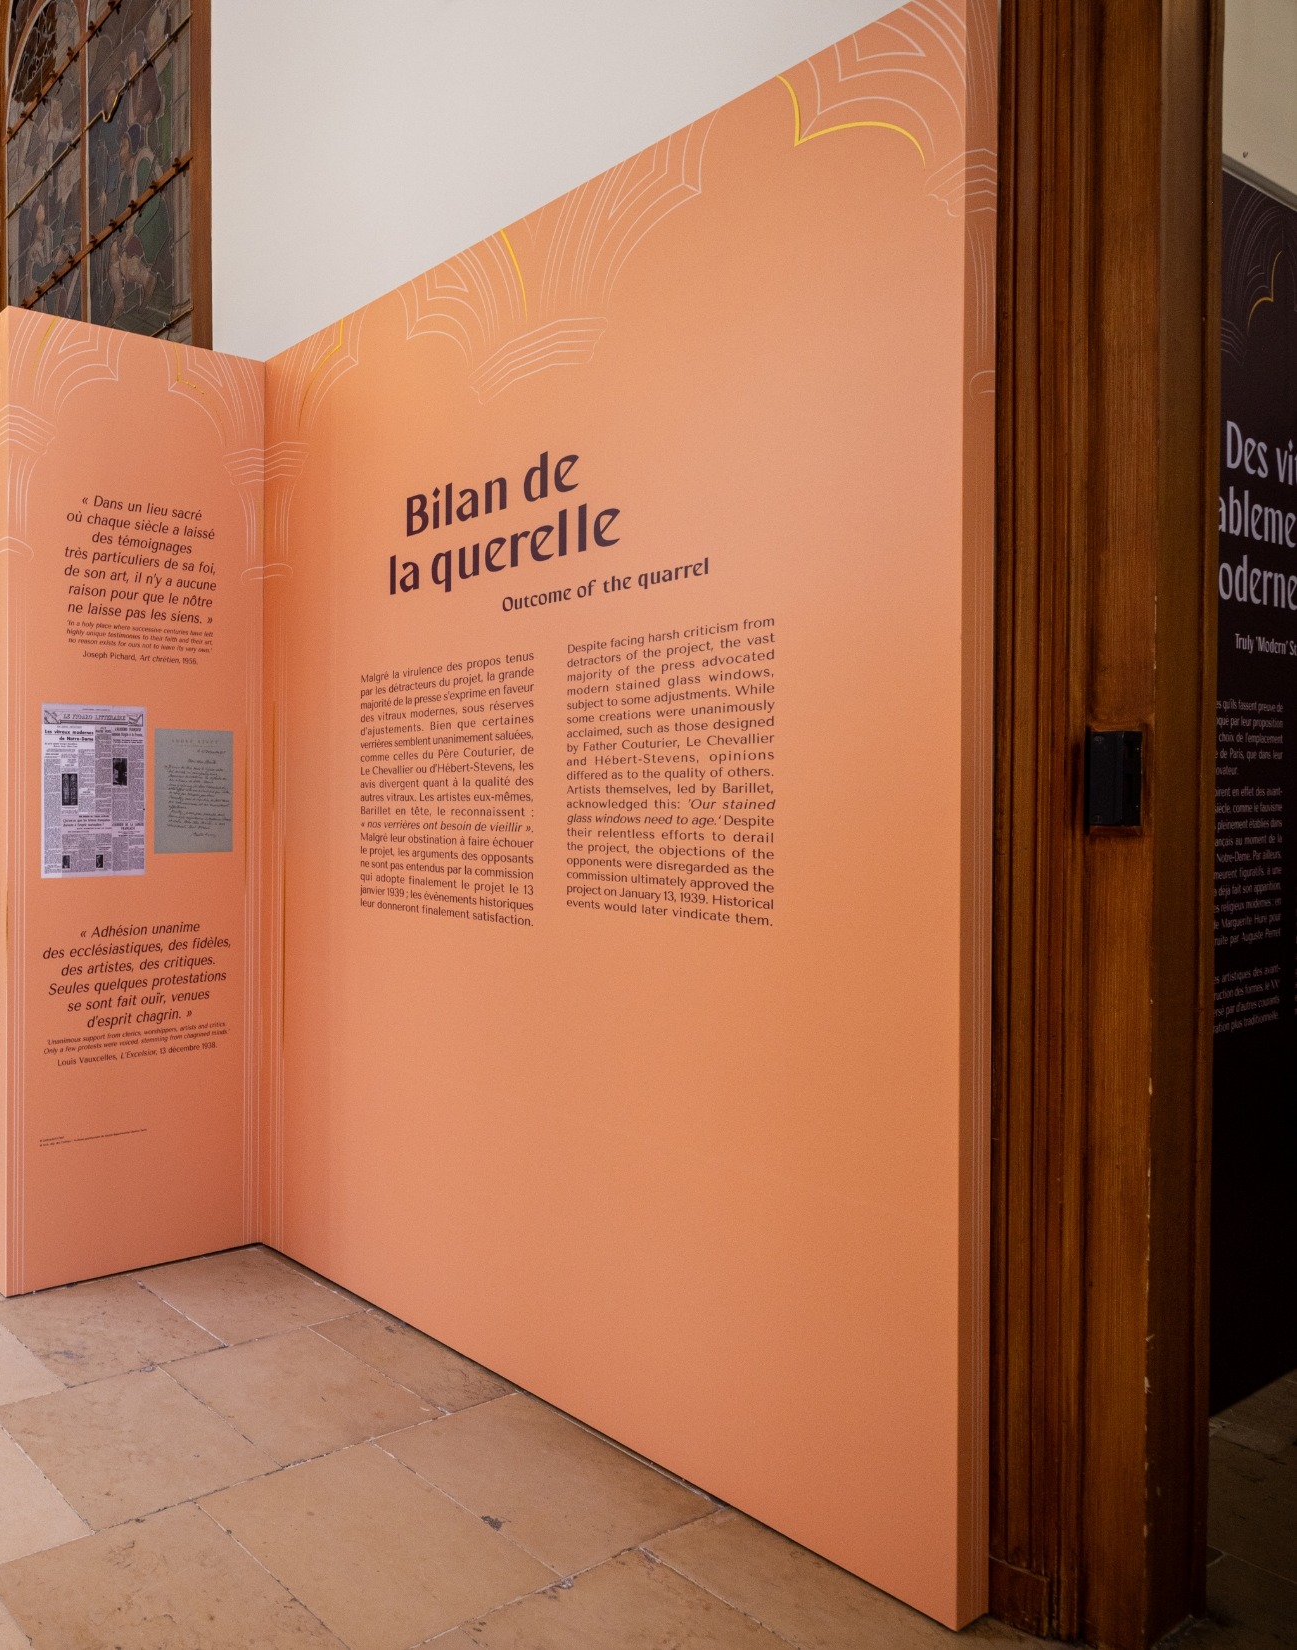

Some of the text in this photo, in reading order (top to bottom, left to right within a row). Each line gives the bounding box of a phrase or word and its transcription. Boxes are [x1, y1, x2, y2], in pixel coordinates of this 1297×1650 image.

[1227, 420, 1297, 485] Des vi
[406, 451, 579, 537] Bilan de
[93, 495, 124, 510] Dans
[128, 502, 142, 512] un
[146, 502, 168, 516] lieu
[171, 509, 202, 521] sacré
[66, 510, 215, 540] où chaque siècle a laissé
[92, 531, 192, 556] des témoignages
[390, 503, 620, 596] la querelle
[64, 546, 216, 576] très particuliers de sa foi,
[64, 564, 217, 592] de son art, il n'y a aucune
[502, 557, 708, 612] Outcome of the quarrel
[68, 584, 213, 608] raison pour que le nôtre
[68, 604, 83, 614] ne
[87, 602, 122, 617] laisse
[125, 608, 146, 621] pas
[150, 608, 167, 621] les
[170, 610, 202, 624] siens.
[567, 618, 775, 654] Despite facing harsh criticism from
[1235, 633, 1289, 654] Truly 'Modern'
[82, 650, 198, 666] Joseph Pichard, Art chrétien, 1956.
[566, 632, 775, 668] detractors of the project, the vast
[361, 652, 534, 684] Malgré la virulence des propos tenus
[360, 666, 534, 699] par les détracteurs du projet, la grande
[91, 924, 148, 938] Adhésion
[152, 921, 200, 935] unanime
[42, 936, 231, 960] des ecclésiastiques, des fidèles,
[61, 955, 216, 976] des artistes, des critiques.
[48, 971, 226, 996] Seules quelques protestations
[67, 990, 210, 1012] se sont fait ouïr, venues
[87, 1012, 132, 1030] d'esprit
[136, 1010, 181, 1025] chagrin.
[57, 1041, 218, 1067] Louis Vauxcelles, L'Excelsior, 13 décembre 1938.
